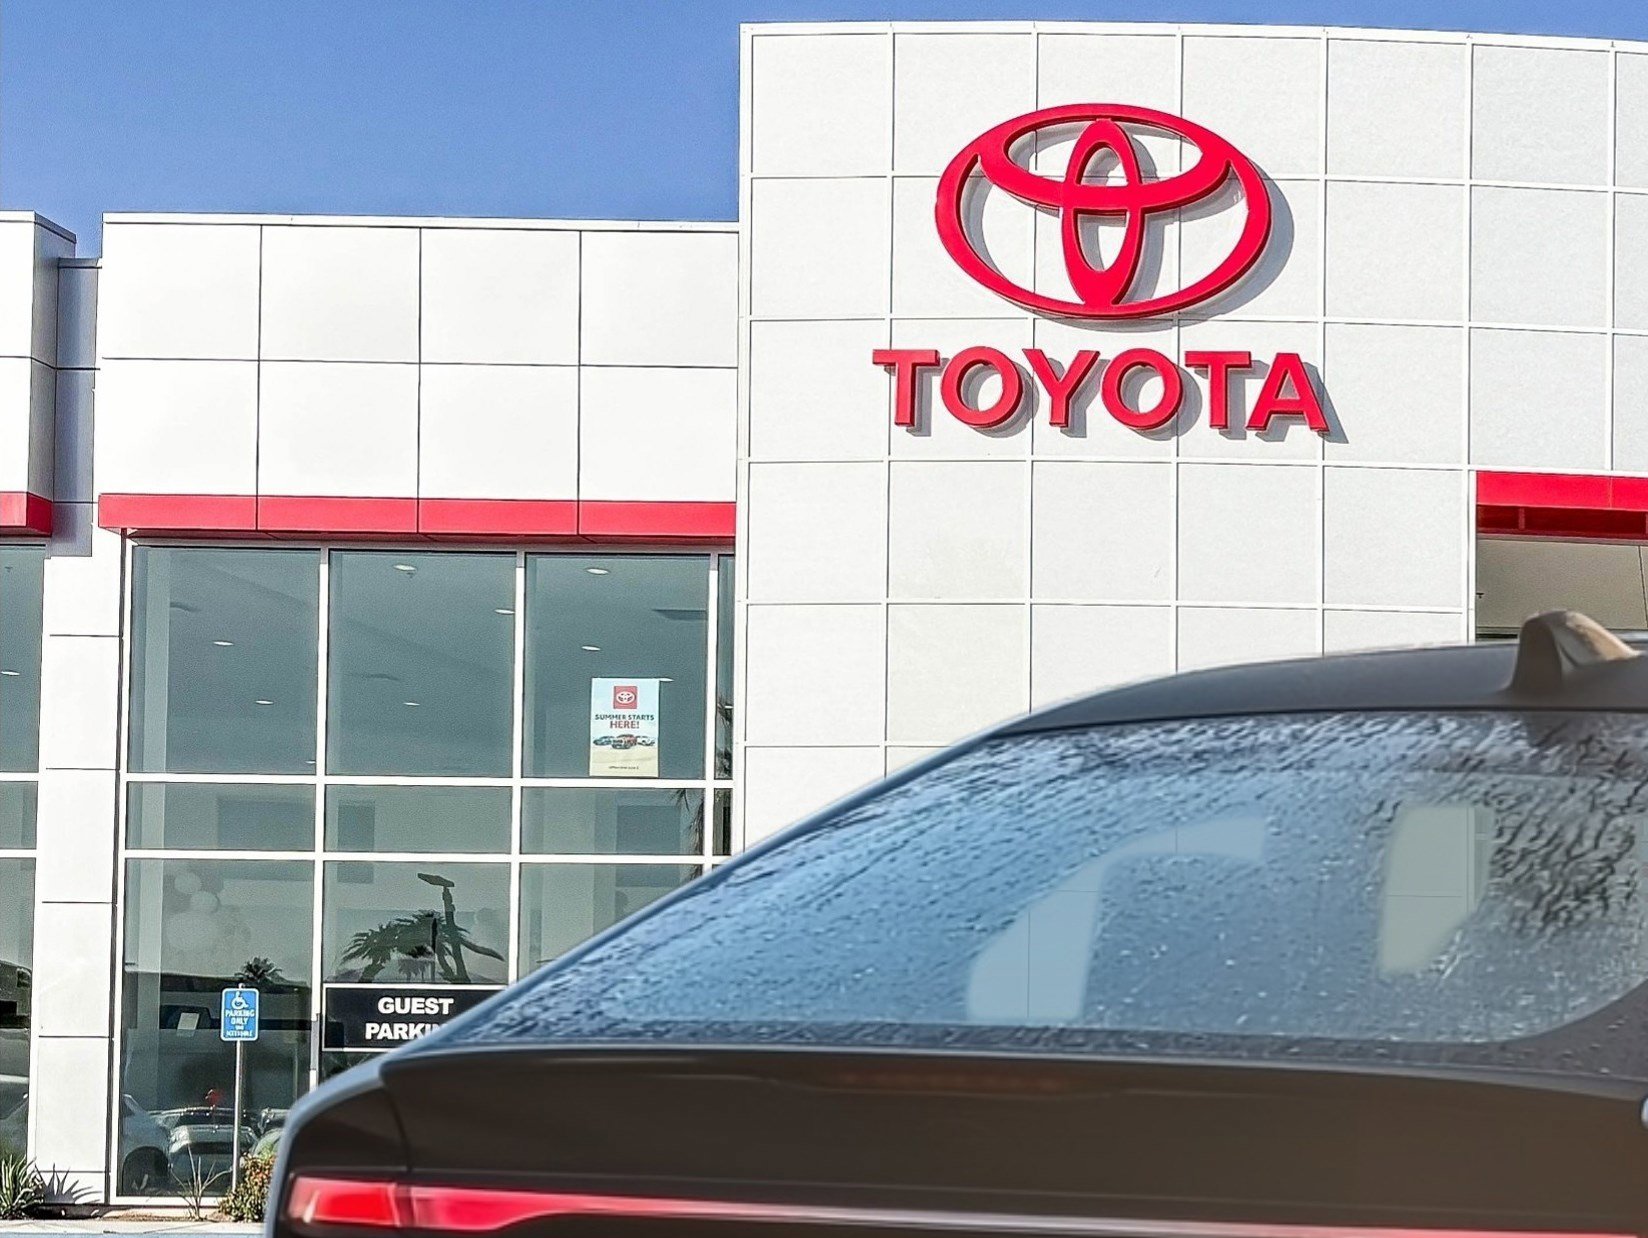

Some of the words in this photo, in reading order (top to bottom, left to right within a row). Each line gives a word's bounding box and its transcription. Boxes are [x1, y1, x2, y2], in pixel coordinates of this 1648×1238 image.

[872, 346, 1331, 435] TOYOTA
[609, 720, 640, 729] HERE!
[377, 996, 455, 1015] GUEST
[365, 1022, 445, 1040] PARKI
